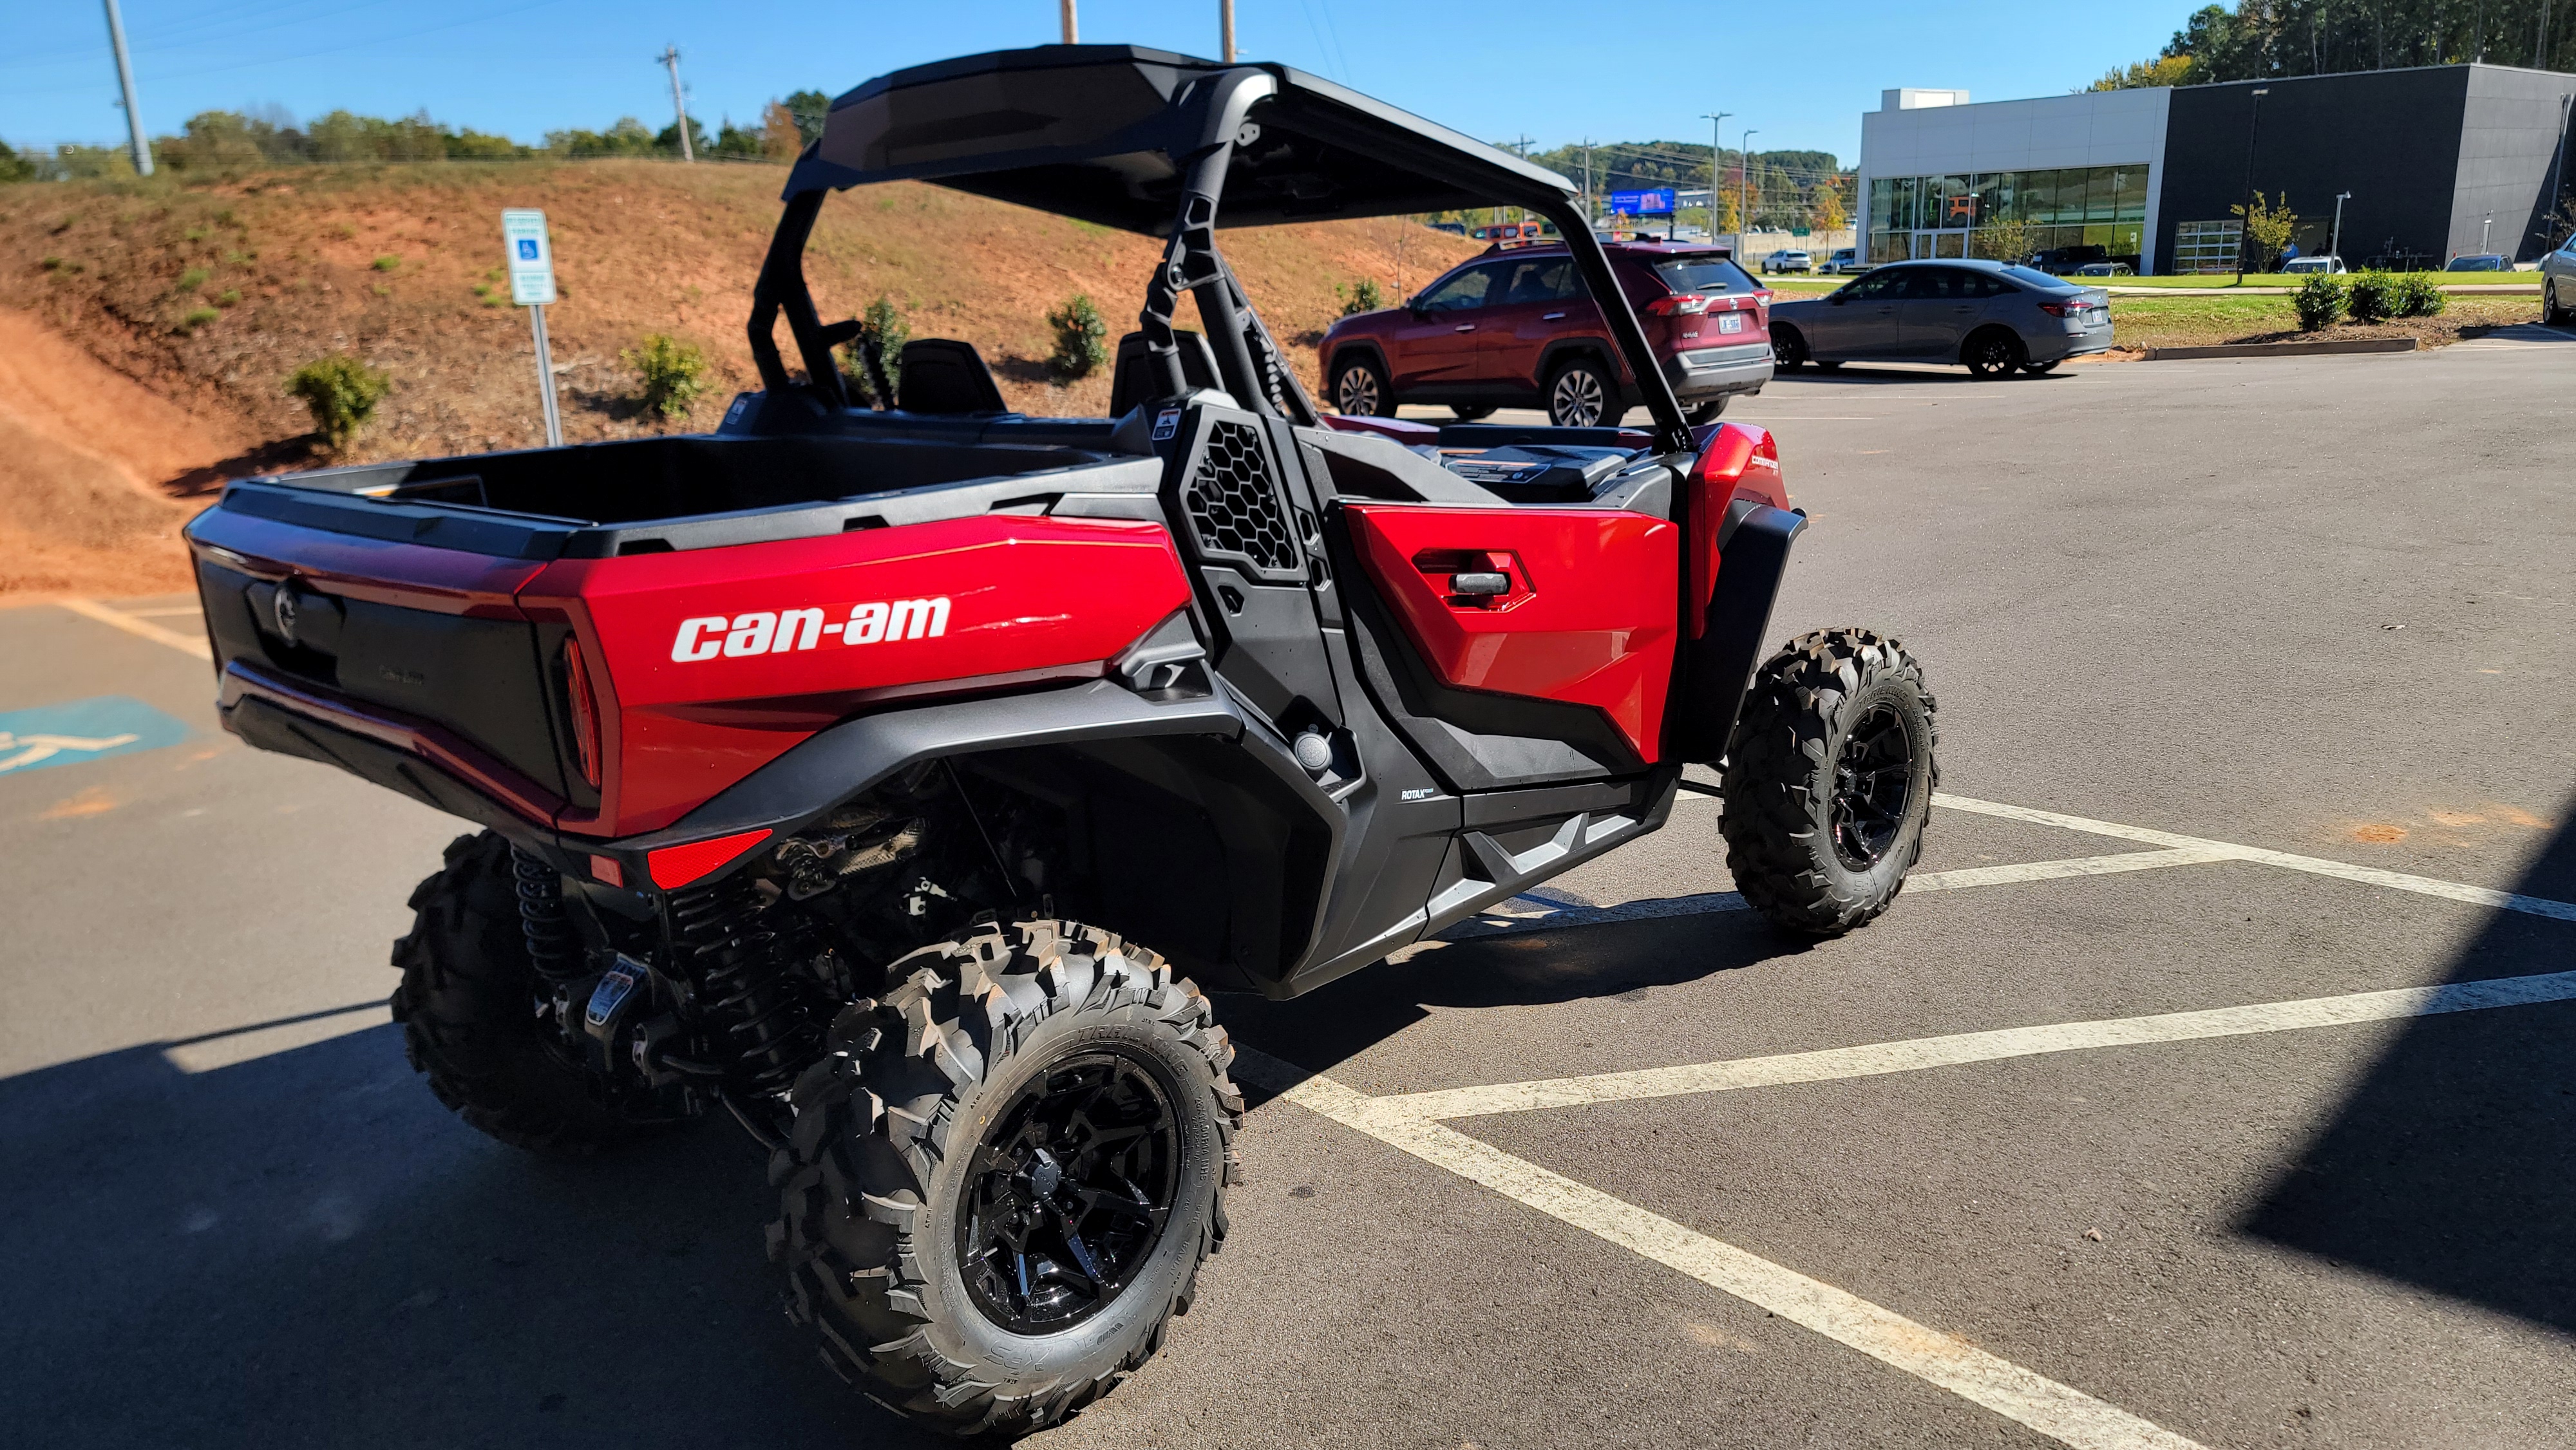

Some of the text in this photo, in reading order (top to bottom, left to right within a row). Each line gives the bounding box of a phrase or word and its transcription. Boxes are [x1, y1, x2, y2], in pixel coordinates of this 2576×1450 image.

[671, 596, 951, 663] can-am
[1401, 789, 1425, 800] ROTAX
[1168, 1240, 1190, 1276] RADIAL
